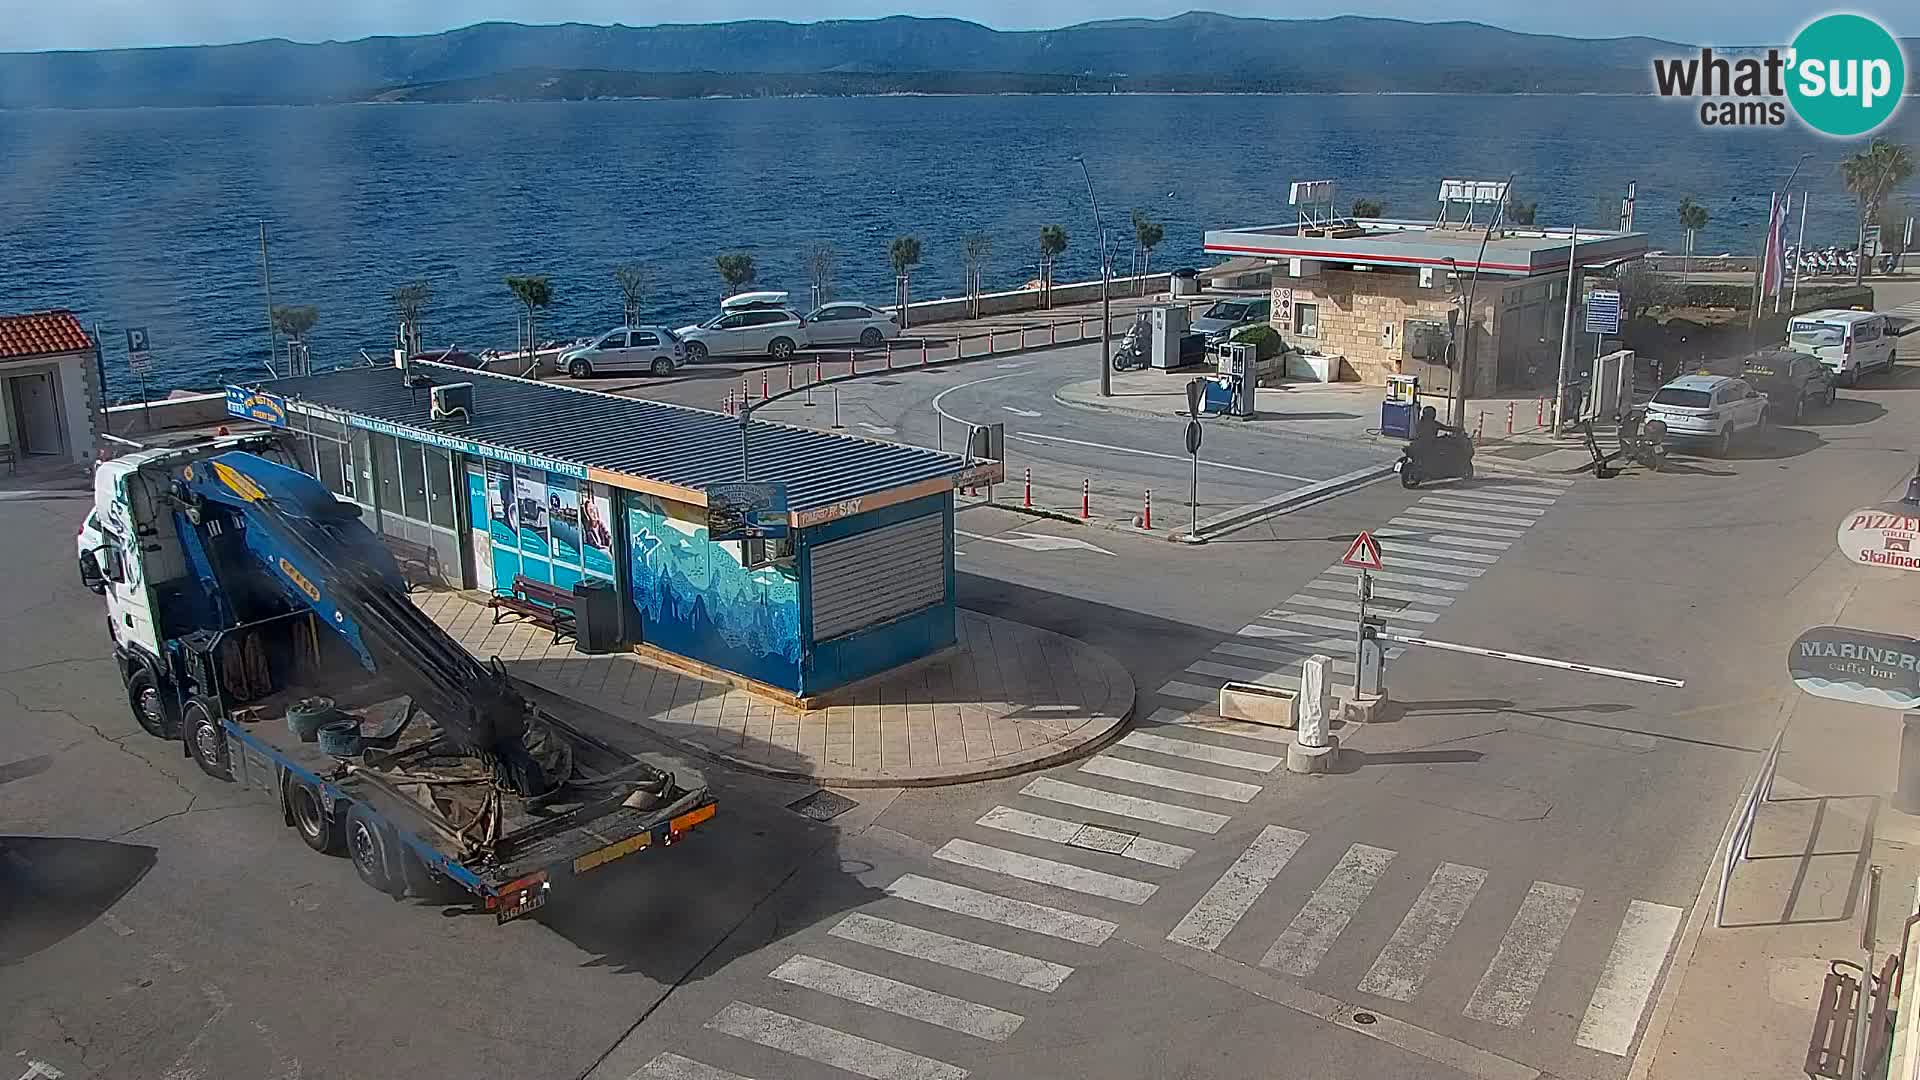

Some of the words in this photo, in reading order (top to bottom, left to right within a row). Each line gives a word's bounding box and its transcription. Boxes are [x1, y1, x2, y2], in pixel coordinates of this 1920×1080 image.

[131, 331, 144, 349] P
[437, 435, 468, 451] POSTAJA
[479, 446, 494, 457] BUS
[494, 449, 527, 464] STATION
[529, 457, 555, 471] TICKET
[556, 461, 583, 477] OFFICE
[1848, 515, 1920, 532] PIZZE
[1870, 665, 1897, 680] bar
